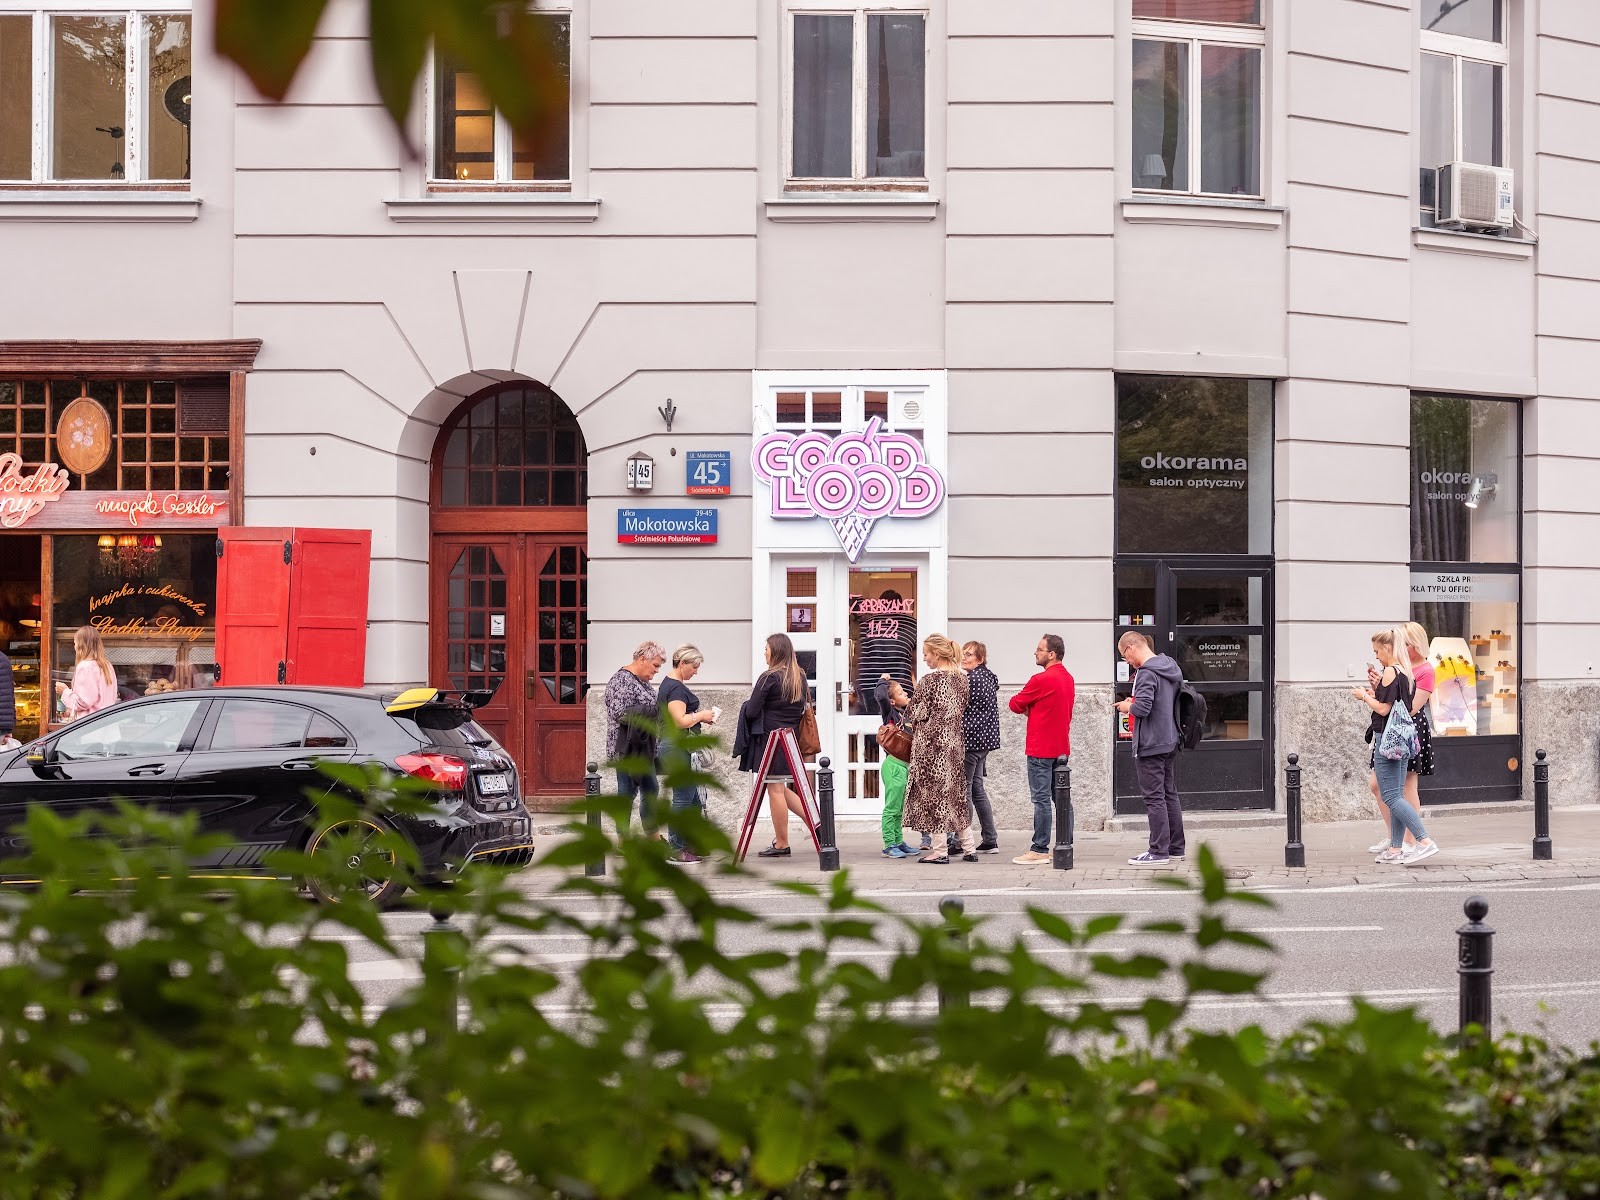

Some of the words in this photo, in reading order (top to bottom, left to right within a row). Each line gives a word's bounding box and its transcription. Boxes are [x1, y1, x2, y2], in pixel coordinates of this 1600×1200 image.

[1140, 452, 1248, 471] okorama
[638, 464, 650, 478] 45
[693, 461, 721, 485] 45
[1149, 476, 1184, 487] salon
[1187, 477, 1245, 490] optyczny
[771, 462, 946, 519] LOOD
[1427, 490, 1453, 500] salon
[163, 493, 226, 515] Gessler
[622, 509, 636, 517] ulica
[695, 509, 713, 517] 39-45
[625, 516, 710, 532] Mokotowska
[634, 534, 667, 542] Śródmieście
[667, 534, 701, 542] Południowe
[1436, 575, 1460, 583] SZKŁA
[1427, 585, 1447, 593] TYPU
[1448, 585, 1474, 593] OFFICE
[89, 582, 135, 613] knajpka
[138, 584, 145, 595] i
[145, 584, 207, 616] cukierenka
[148, 615, 205, 641] Słony
[1198, 642, 1241, 650] okorama
